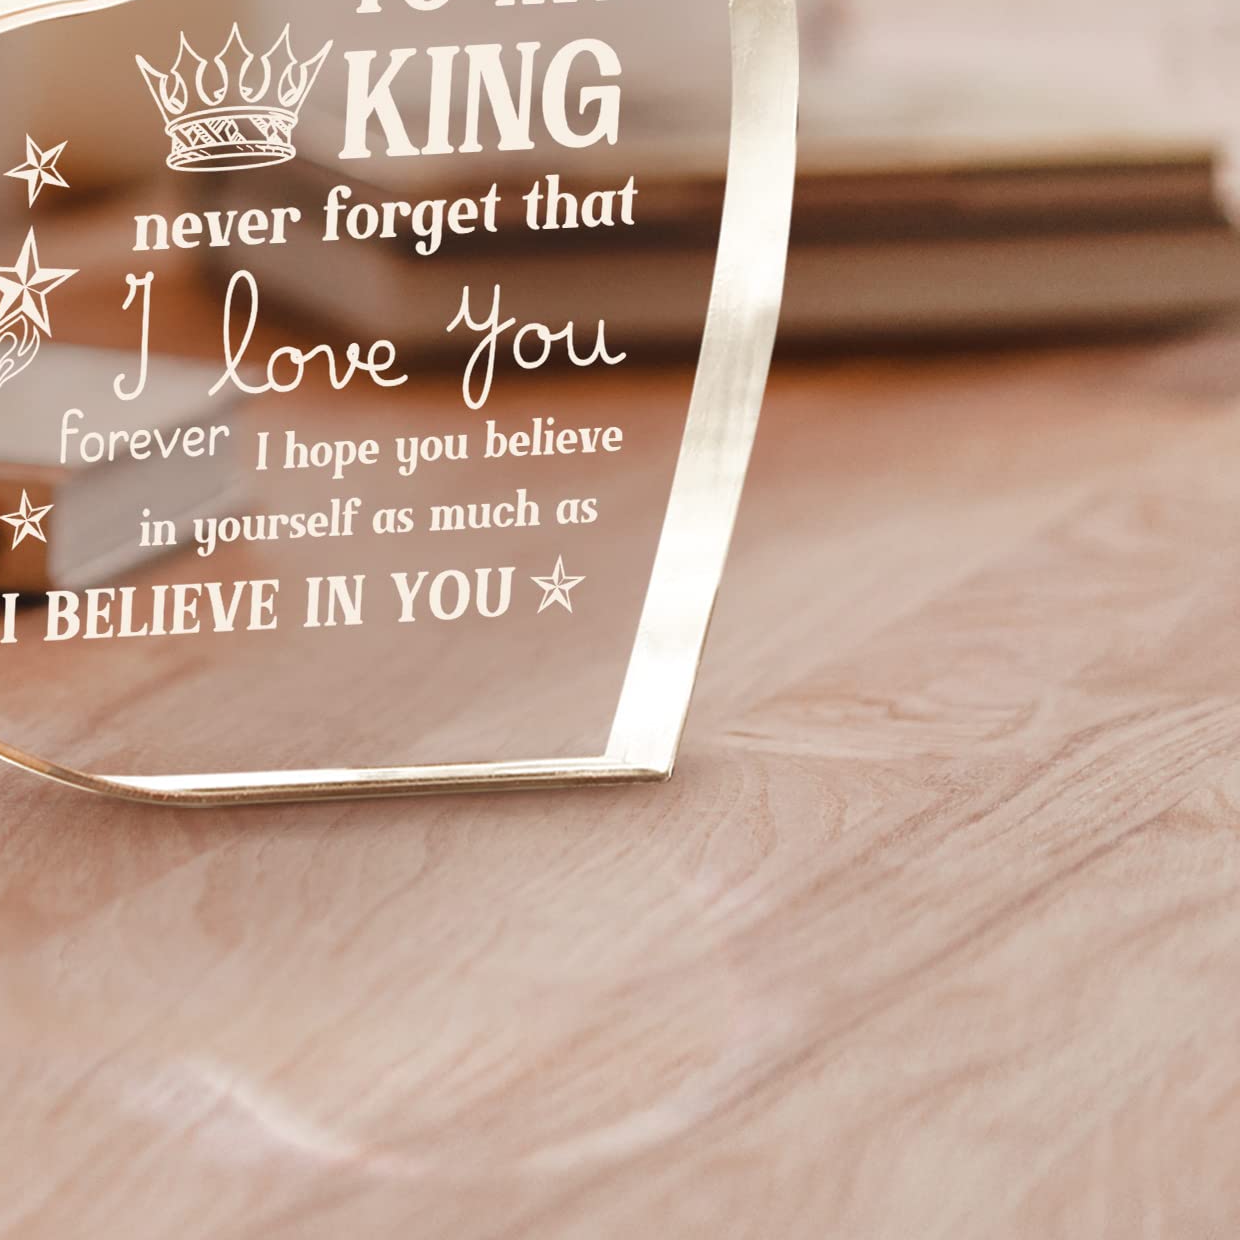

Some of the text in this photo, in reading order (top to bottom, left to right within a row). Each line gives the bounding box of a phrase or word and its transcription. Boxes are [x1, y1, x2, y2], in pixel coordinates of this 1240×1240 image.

[338, 38, 622, 160] KING
[132, 174, 638, 256] never forget that
[207, 269, 408, 397] love
[60, 407, 623, 480] forever I hope you believe
[138, 488, 598, 557] in yourself as much as
[0, 566, 516, 643] I BELIEVE IN YOU
